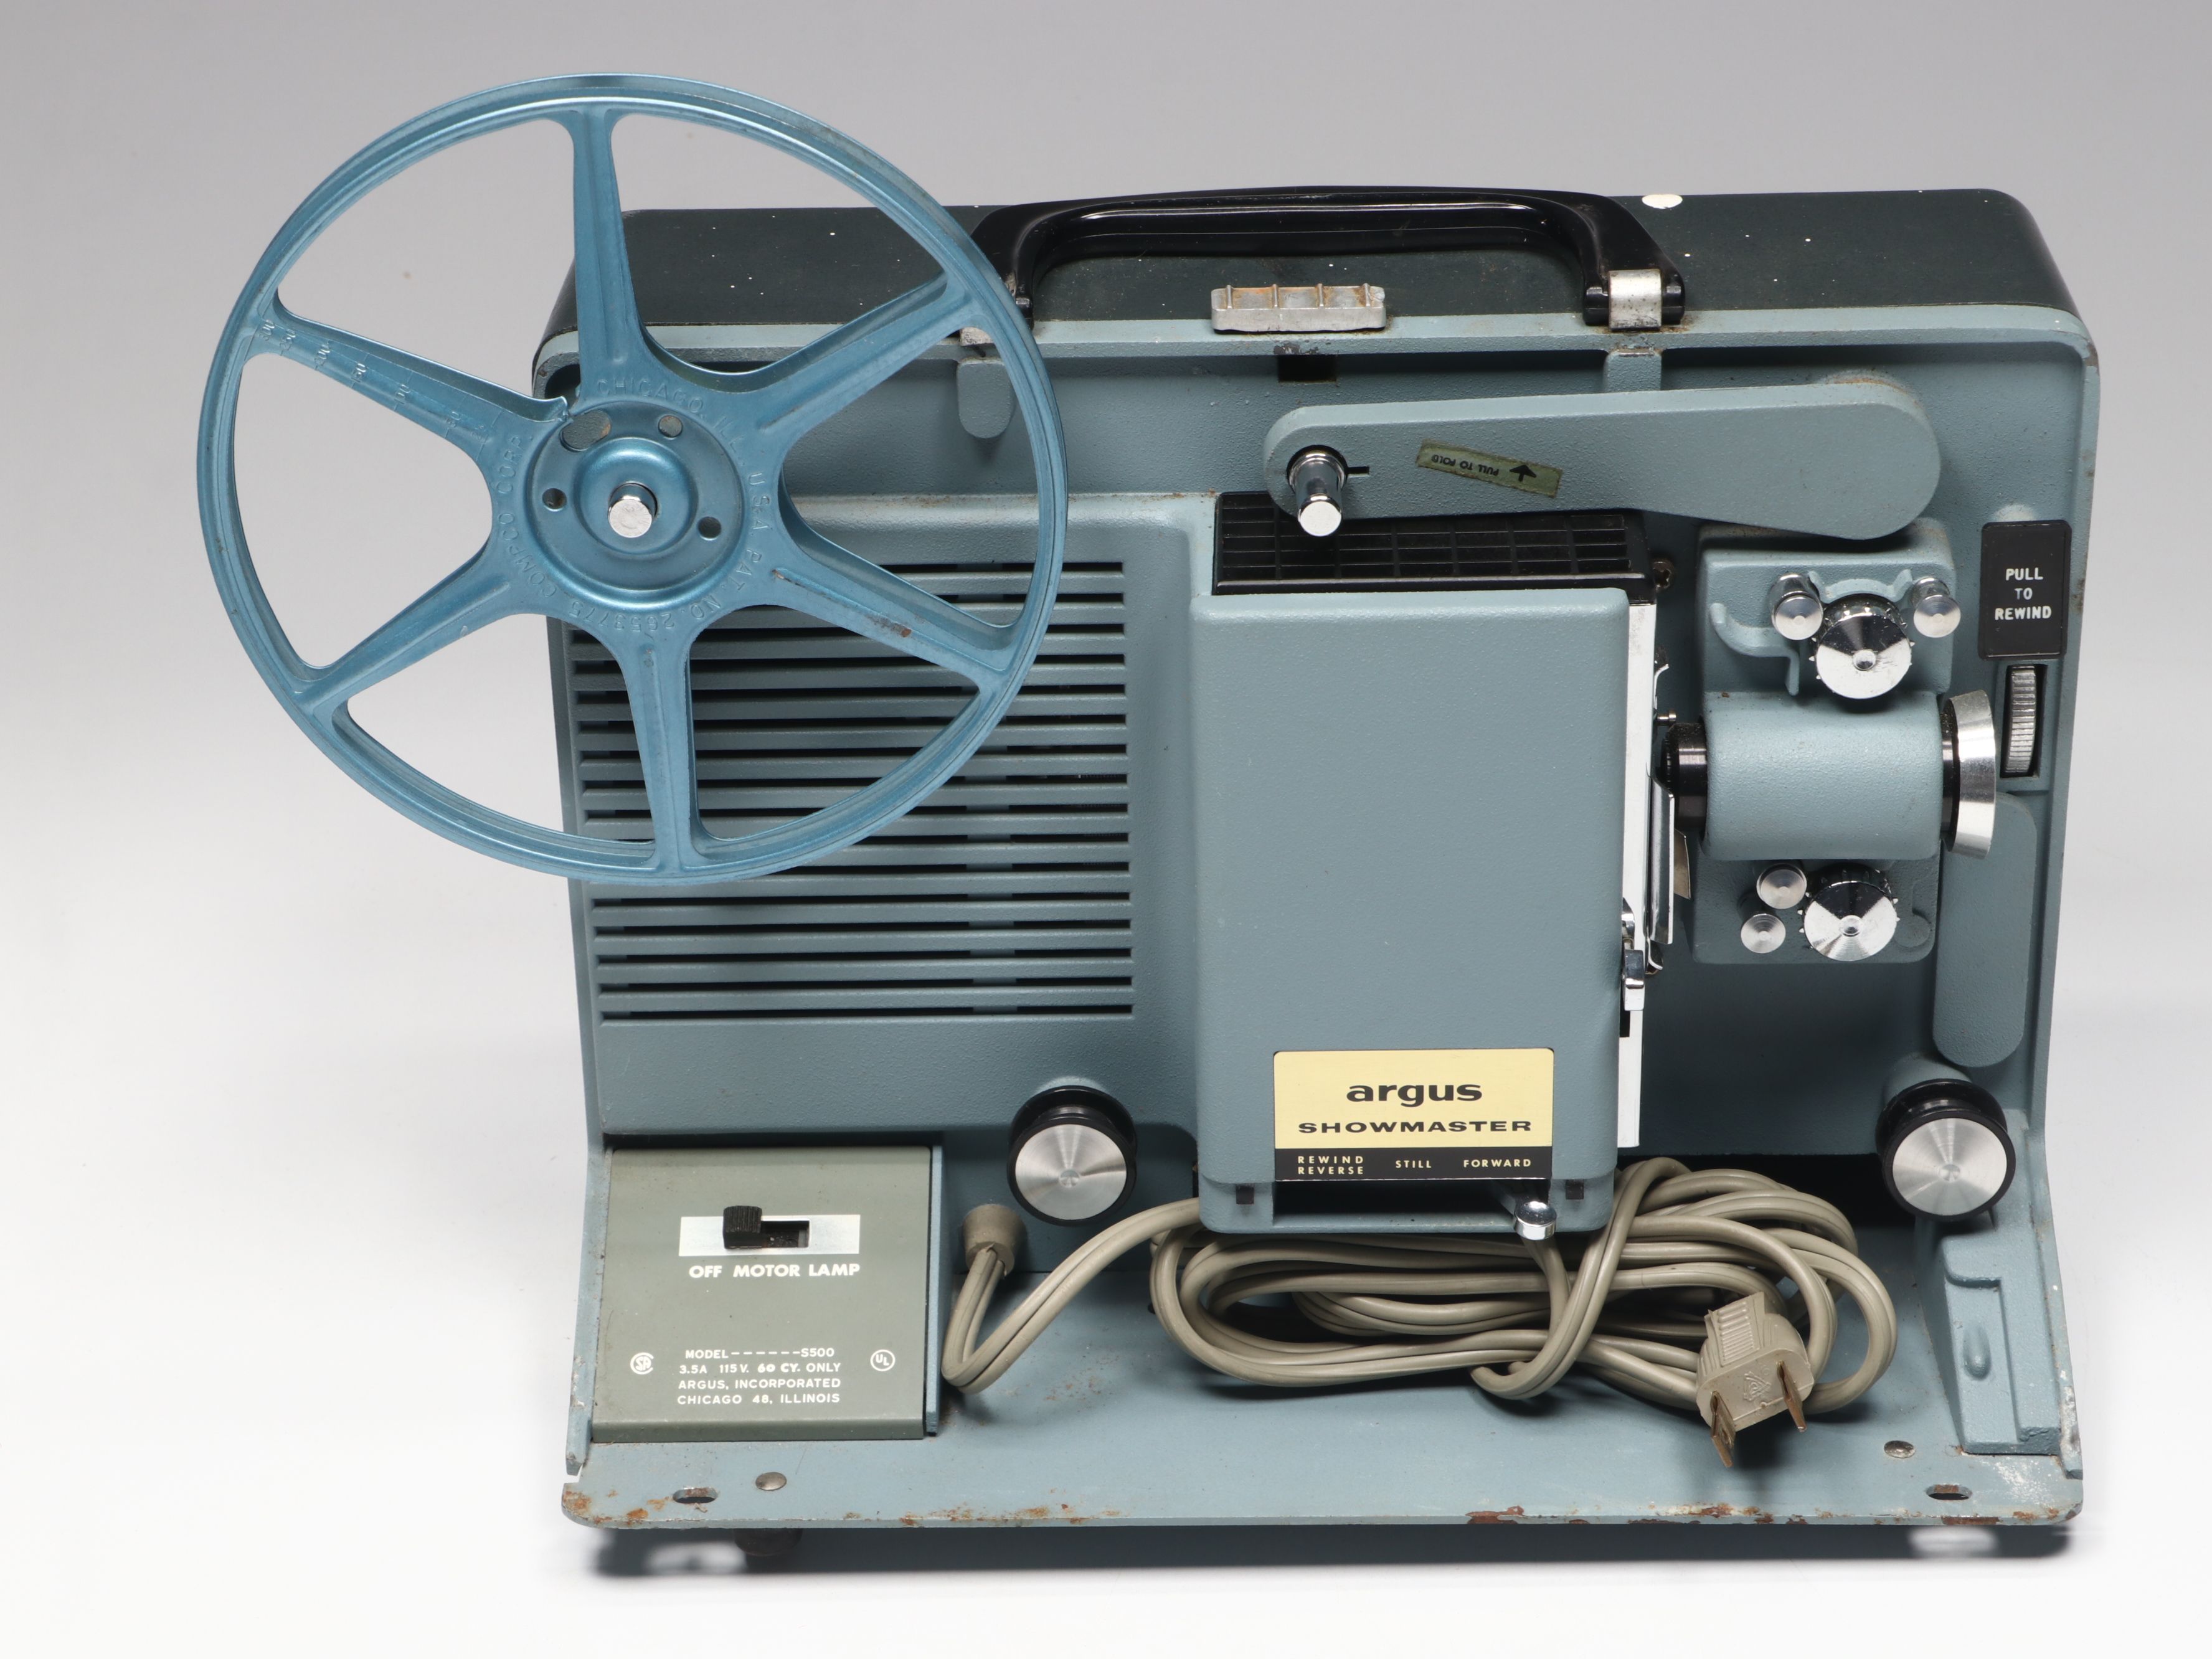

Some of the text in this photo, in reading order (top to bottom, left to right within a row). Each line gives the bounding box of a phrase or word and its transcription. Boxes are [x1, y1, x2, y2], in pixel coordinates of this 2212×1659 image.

[1431, 454, 1500, 476] PULL TO FOLD
[498, 513, 557, 598] COMPCO
[569, 601, 675, 633] 2653775
[2005, 567, 2043, 581] PULL
[2015, 587, 2033, 600] TO
[1995, 605, 2052, 621] REWIND
[1346, 1084, 1483, 1108] argus
[1298, 1121, 1532, 1133] SHOWMASTER
[1298, 1155, 1364, 1164] REWIND
[1396, 1160, 1432, 1169] STILL
[1463, 1158, 1532, 1168] FORWARD
[1298, 1166, 1364, 1175] REVERSE
[689, 1263, 861, 1279] OFF MOTOR LAMP
[679, 1364, 707, 1374] 3.5A
[757, 1363, 776, 1373] 60
[780, 1363, 801, 1373] CY.
[806, 1363, 841, 1373] ONLY
[678, 1378, 841, 1391] ARGUS, INCORPORATED
[677, 1393, 840, 1405] CHICAGO 48, ILLINOIS
